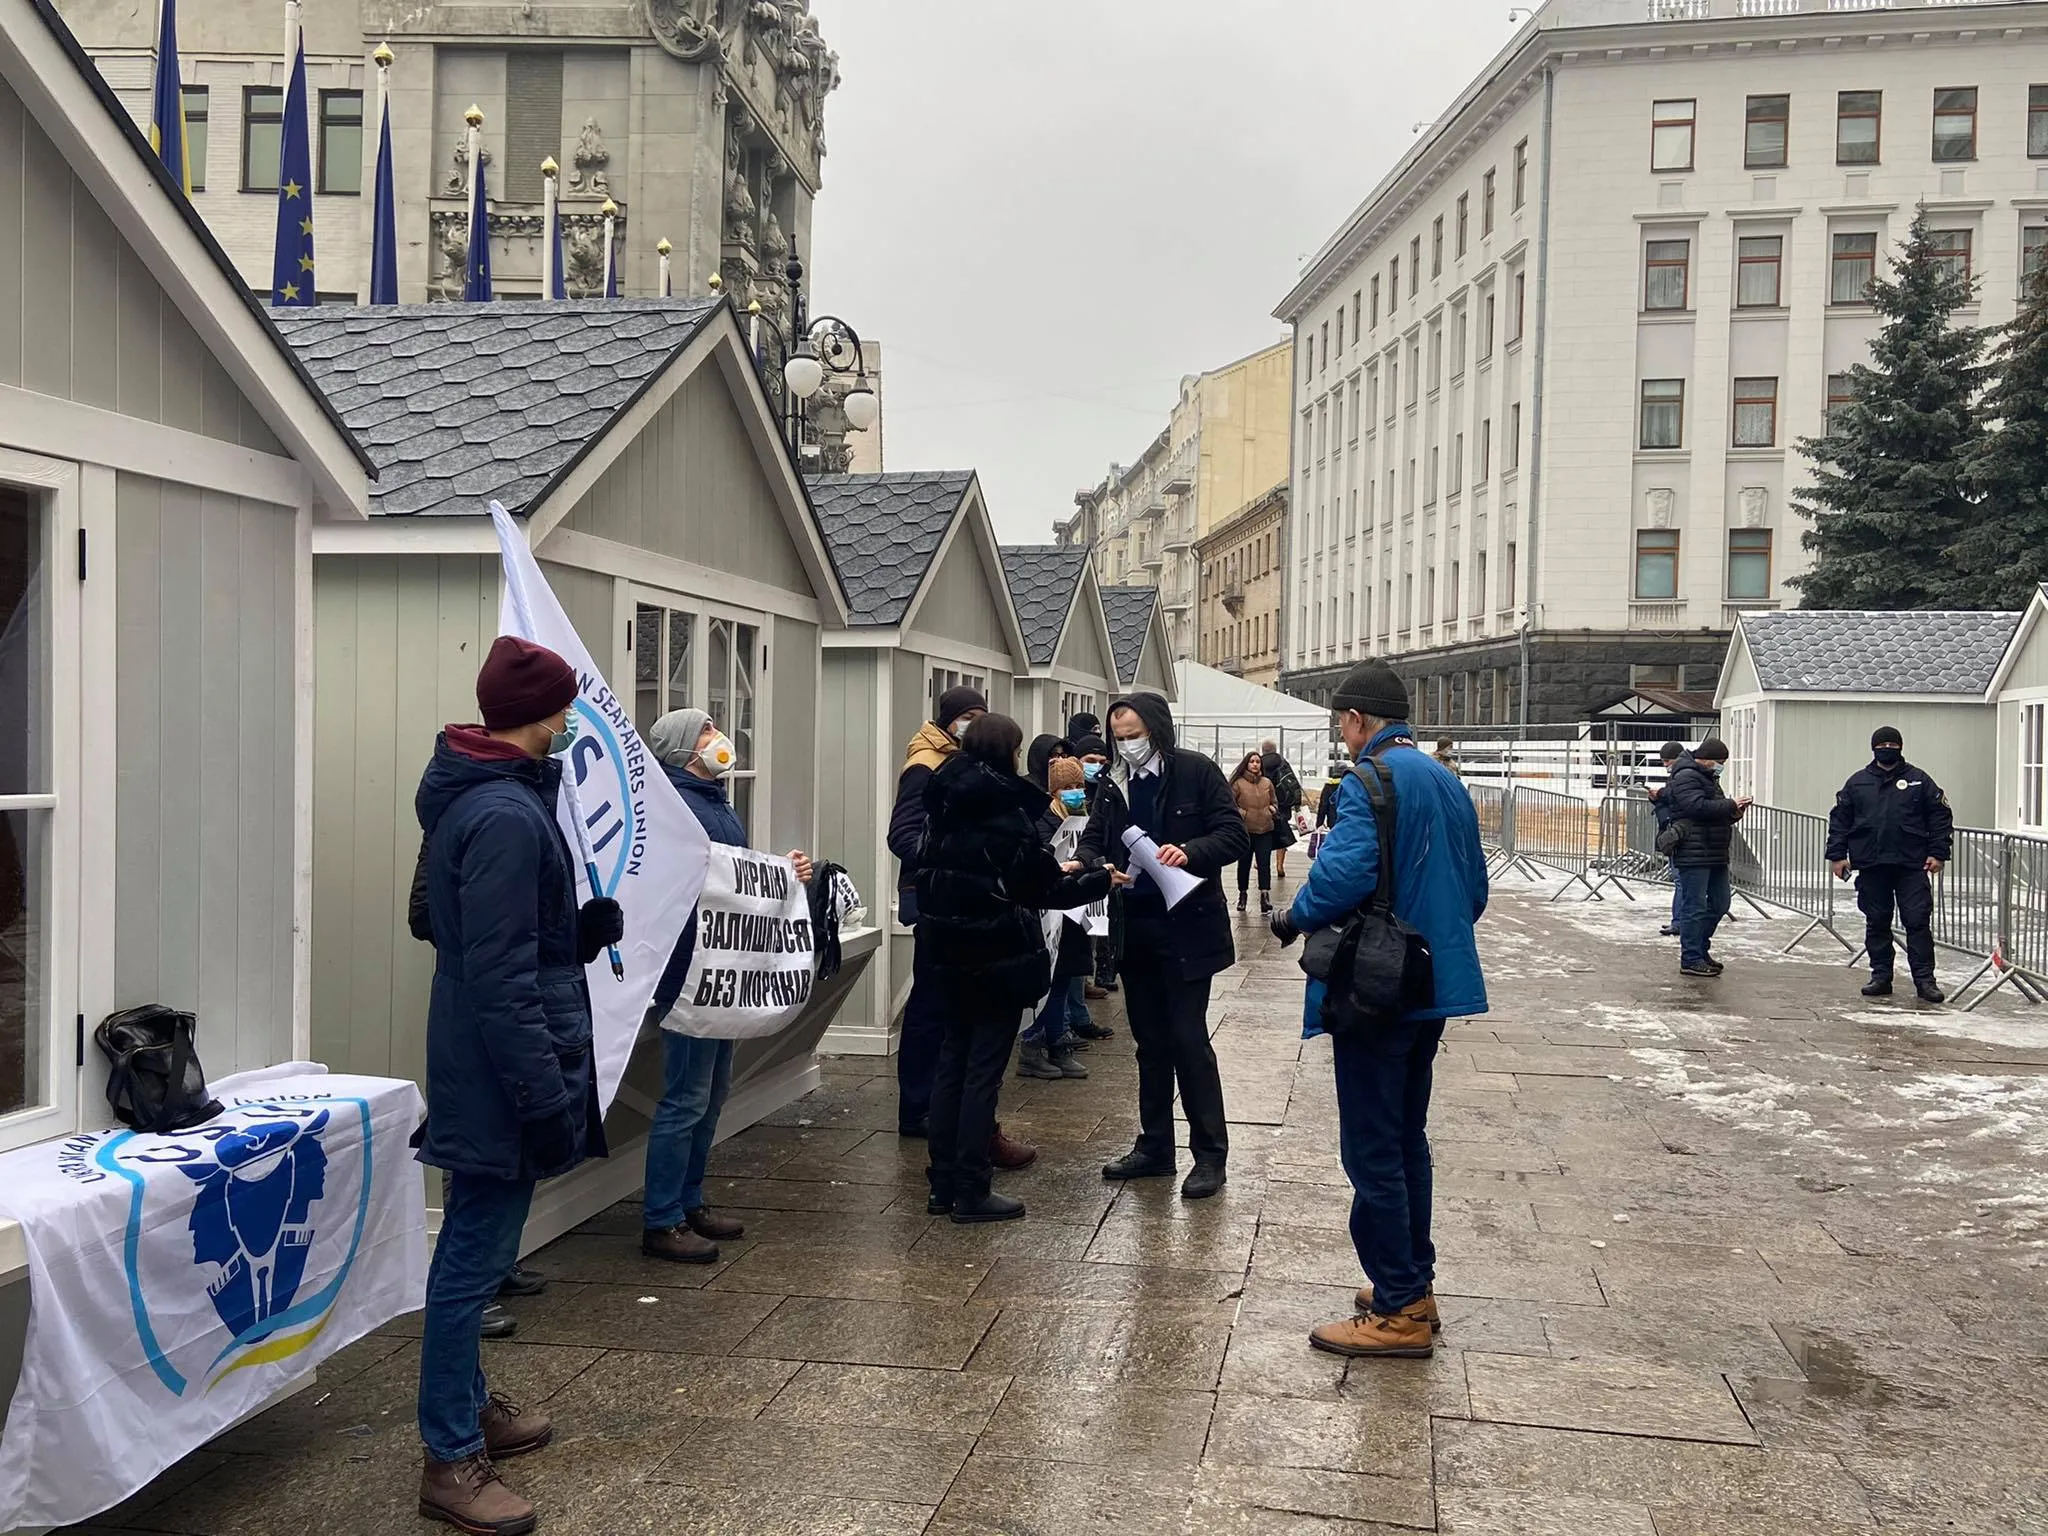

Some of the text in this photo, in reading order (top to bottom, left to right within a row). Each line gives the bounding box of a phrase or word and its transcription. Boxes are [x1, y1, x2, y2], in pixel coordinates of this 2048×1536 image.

[592, 687, 647, 875] SEAFARERS UNION
[693, 968, 811, 1008] БЕЗ МОРЯКІВ
